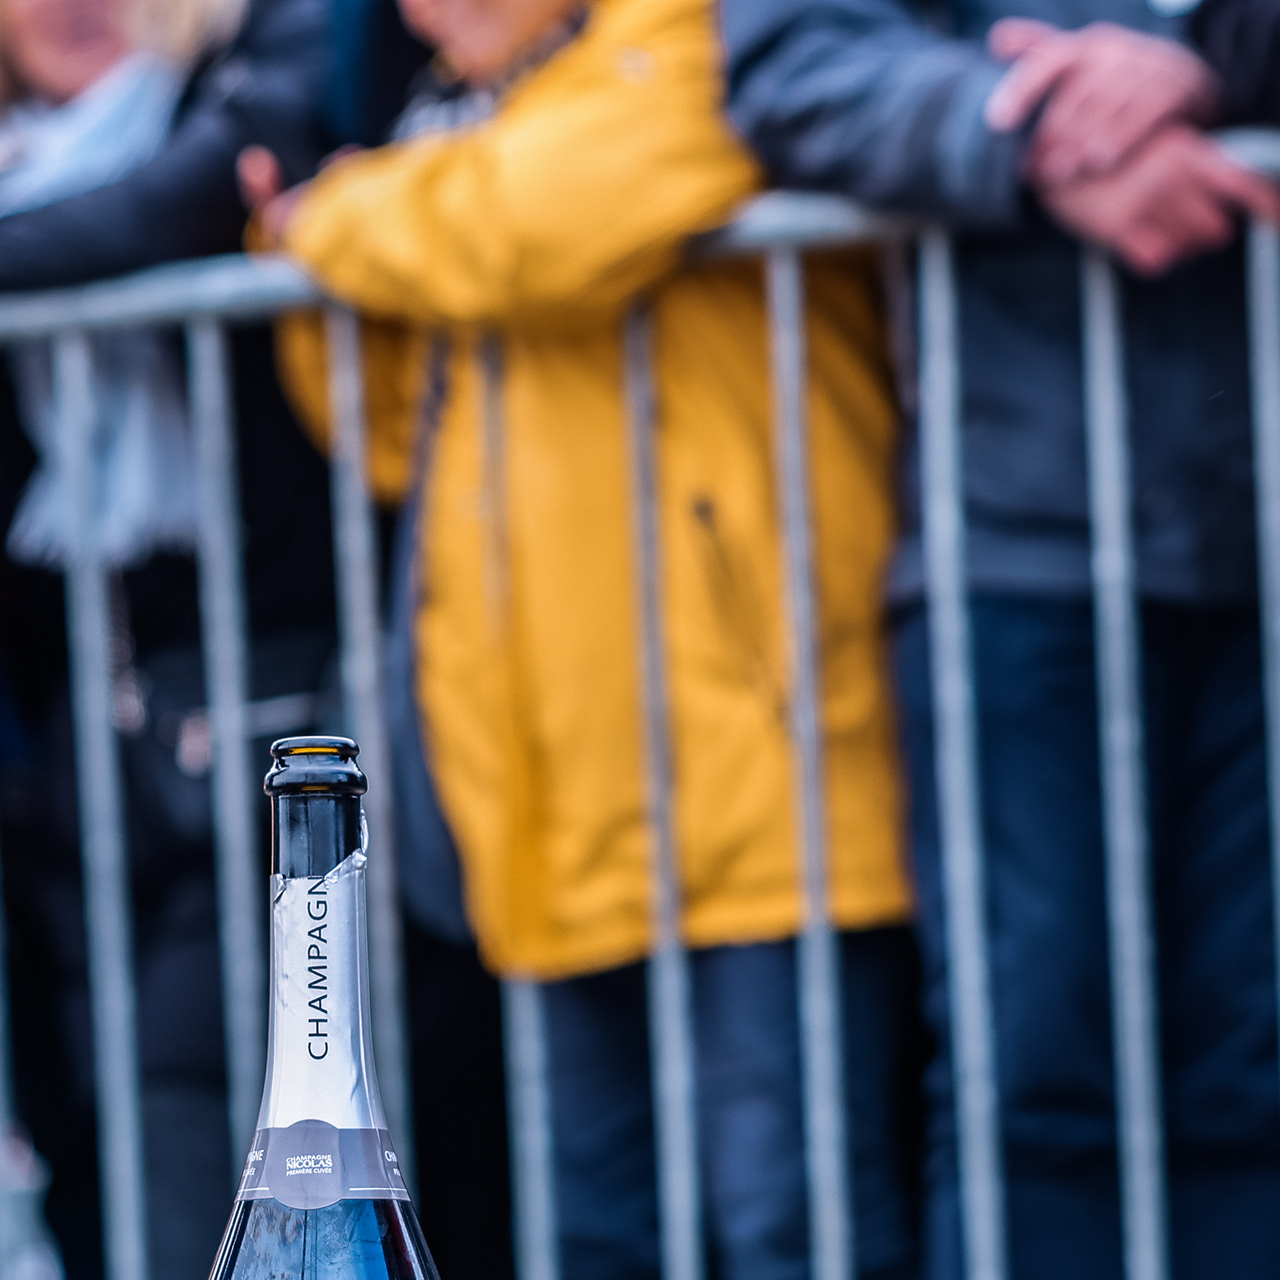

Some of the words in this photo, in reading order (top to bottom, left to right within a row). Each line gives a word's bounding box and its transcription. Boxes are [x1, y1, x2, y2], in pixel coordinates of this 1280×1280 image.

[286, 1154, 332, 1162] CHAMPAGNE
[286, 1159, 333, 1170] NICOLAS
[286, 1167, 312, 1176] PREMIÈRE
